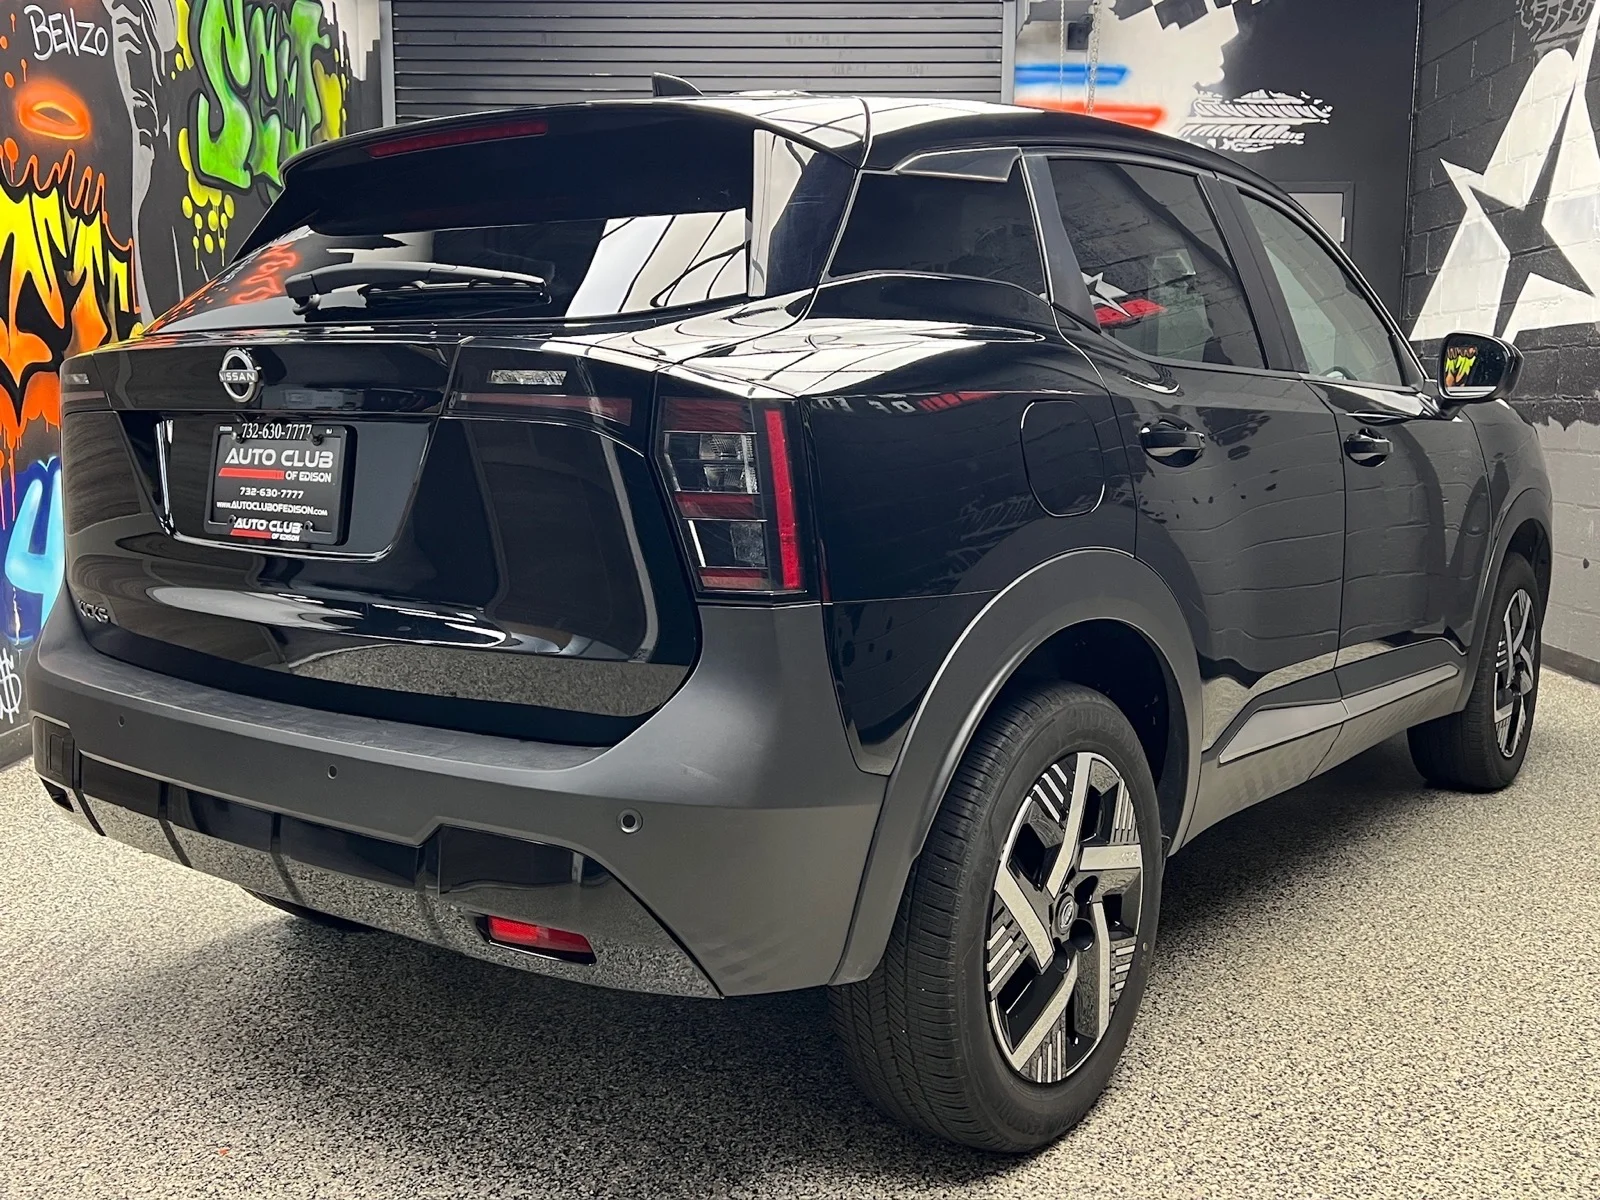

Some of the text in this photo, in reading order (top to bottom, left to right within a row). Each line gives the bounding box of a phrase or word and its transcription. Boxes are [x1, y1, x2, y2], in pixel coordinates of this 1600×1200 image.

[24, 5, 109, 60] BENZO
[219, 372, 256, 382] NISSAN
[241, 422, 313, 440] 732-630-7777
[224, 447, 334, 469] AUTO CLUB
[285, 470, 332, 483] OF EDISON
[239, 486, 304, 499] 732-630-7777
[234, 517, 301, 534] AUTO CLUB
